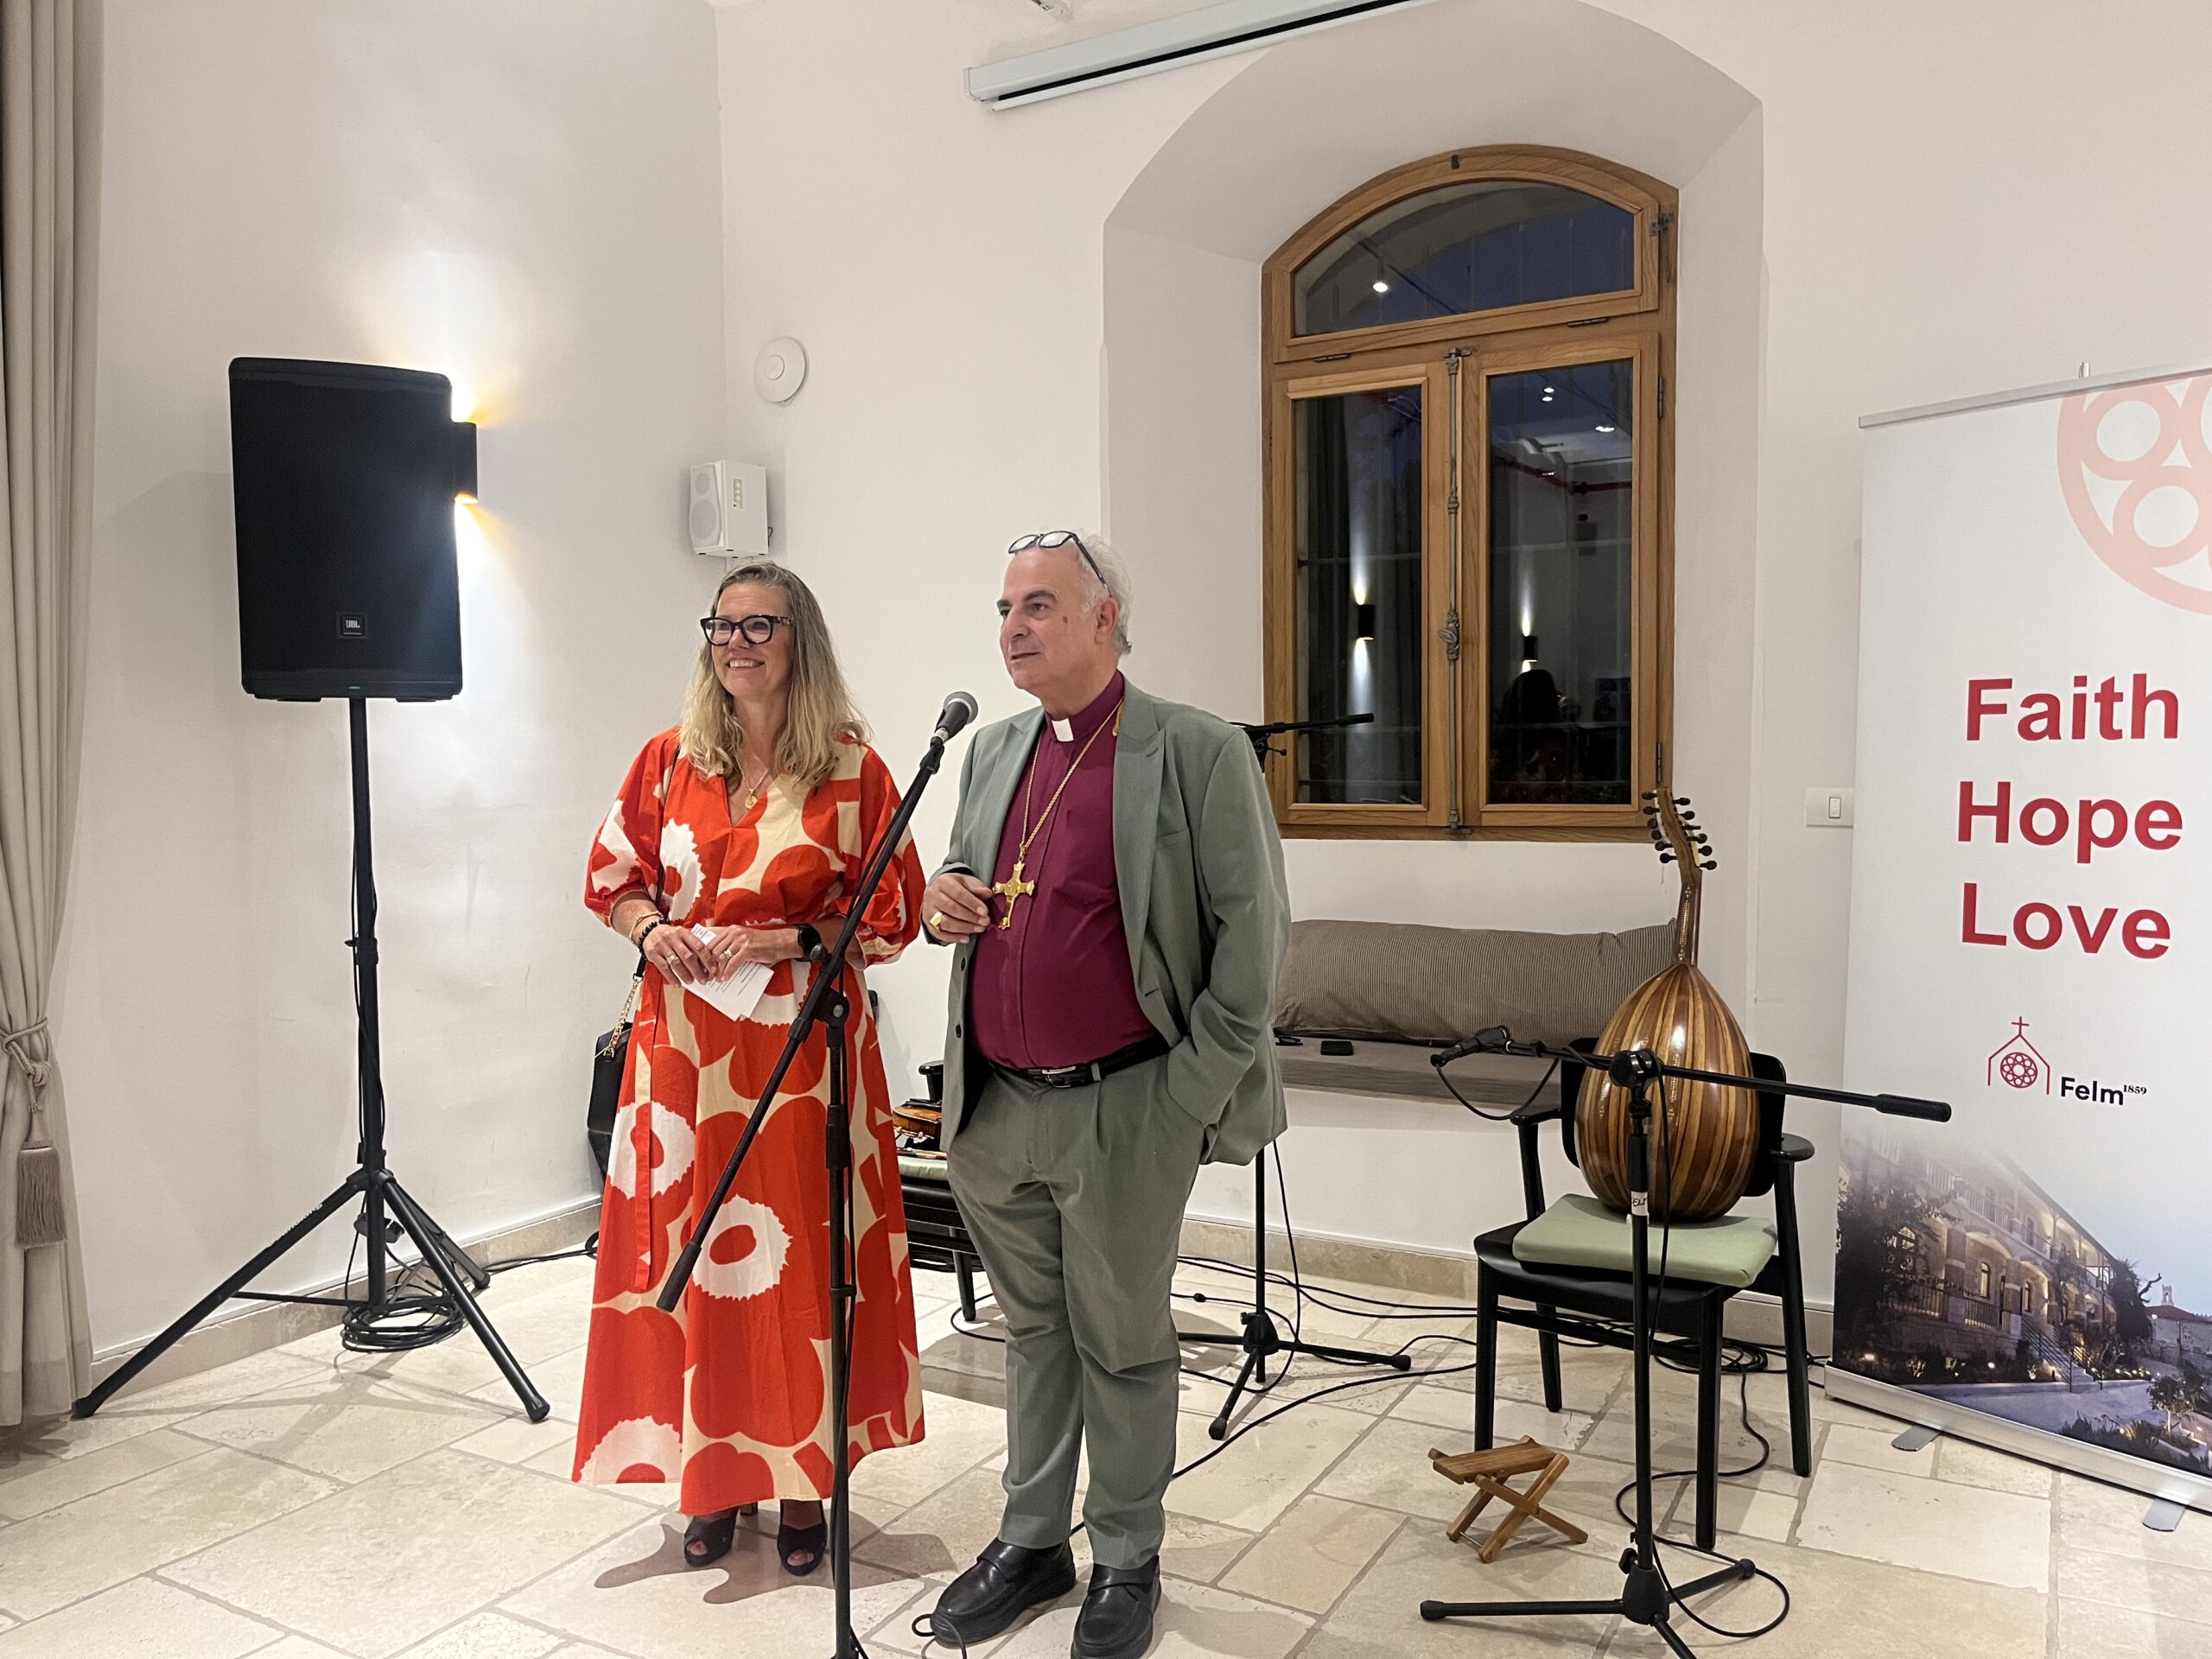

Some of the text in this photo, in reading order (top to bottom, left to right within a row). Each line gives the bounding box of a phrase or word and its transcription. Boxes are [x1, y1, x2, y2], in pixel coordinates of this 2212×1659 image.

[346, 620, 360, 628] JBL
[1967, 673, 2178, 741] Faith
[1958, 781, 2183, 863] Hope
[1962, 882, 2171, 958] Love
[2061, 1077, 2147, 1105] Felm 1859
